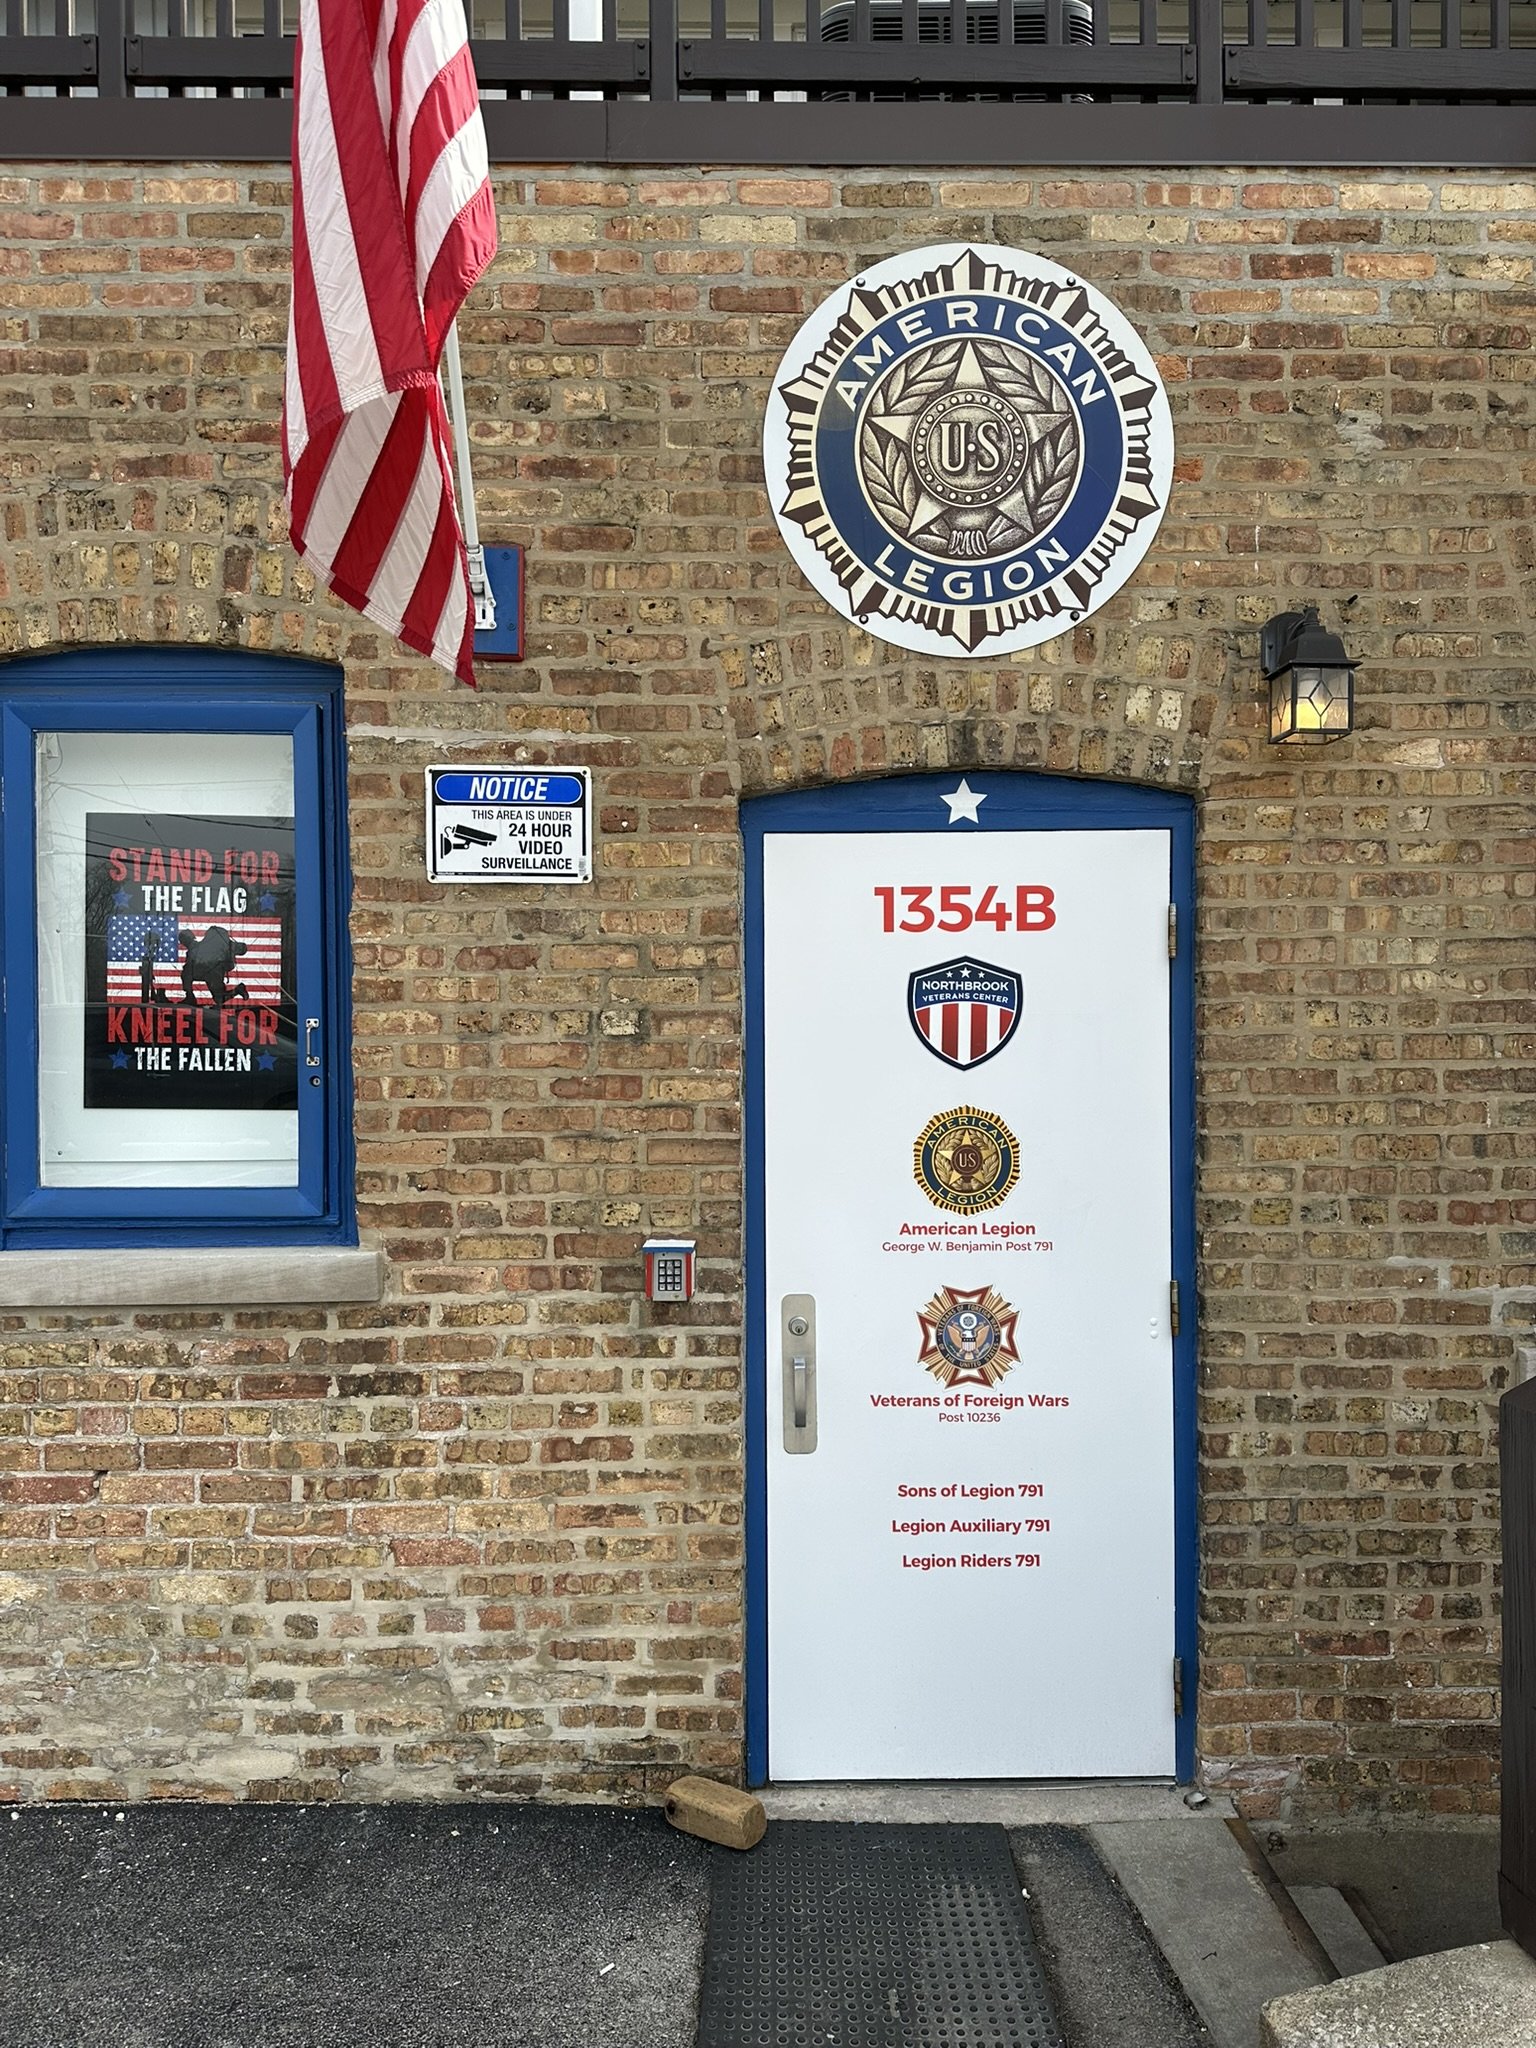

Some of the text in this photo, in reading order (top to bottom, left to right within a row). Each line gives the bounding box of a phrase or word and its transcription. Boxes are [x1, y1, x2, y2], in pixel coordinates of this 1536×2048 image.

[834, 301, 1106, 413] AMERICAN
[874, 536, 1070, 598] LEGION
[469, 777, 549, 800] NOTICE
[472, 810, 572, 821] THIS AREA IS UNDER
[508, 824, 572, 838] 24 HOUR
[519, 841, 563, 855] VIDEO
[109, 848, 280, 885] STAND FOR
[481, 857, 572, 870] SURVEILLANCE
[142, 885, 247, 913] THE FLAG
[874, 885, 1057, 933] 1354B
[922, 980, 1009, 991] NORTHBROOK
[922, 993, 1009, 1004] VETERANS CENTER
[107, 1007, 279, 1045] KNEEL FOR
[134, 1047, 251, 1072] THE FALLEN
[927, 1117, 1007, 1149] AMERICAN
[937, 1186, 998, 1204] LEGION
[899, 1222, 1036, 1238] American Legion
[882, 1241, 1053, 1254] George W. Benjamin Post 791
[870, 1393, 1069, 1410] Veterans of Foreign Wars
[939, 1413, 1001, 1423] Post 10236
[897, 1484, 1044, 1500] Sons of Legion 791
[892, 1518, 1050, 1535] Legion Auxiliary 791
[903, 1554, 1041, 1570] Legion Riders 791
